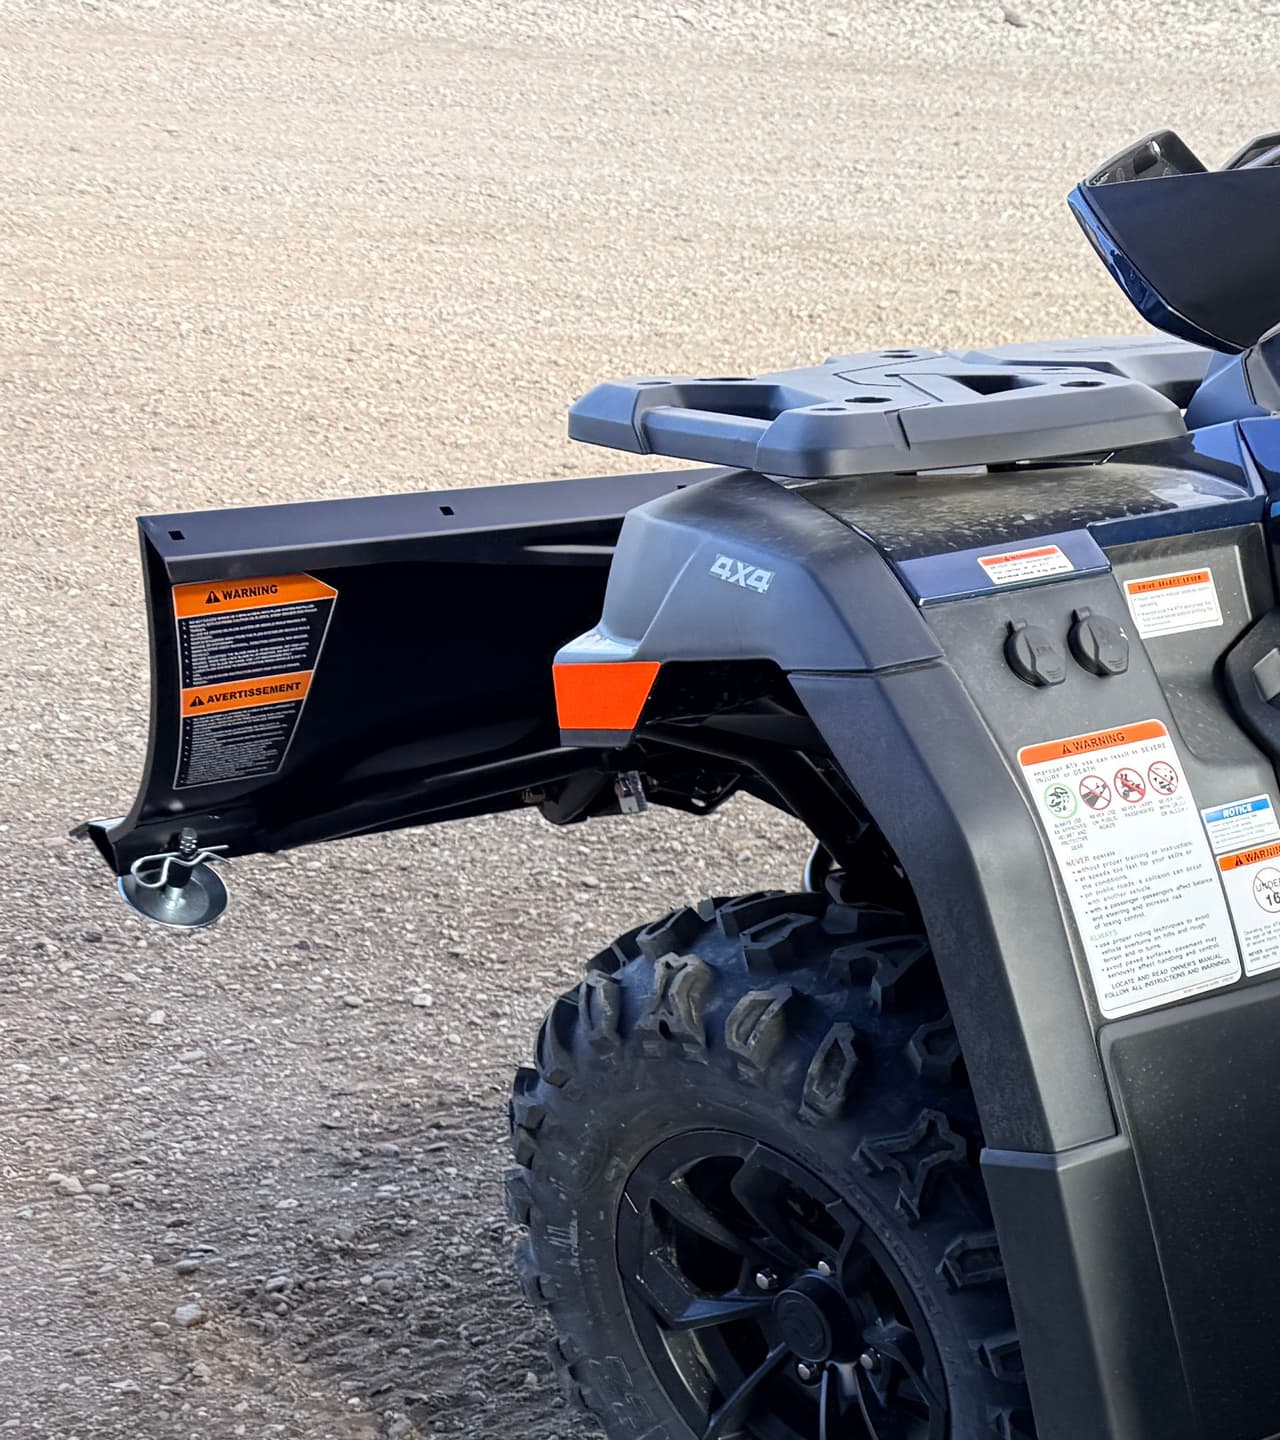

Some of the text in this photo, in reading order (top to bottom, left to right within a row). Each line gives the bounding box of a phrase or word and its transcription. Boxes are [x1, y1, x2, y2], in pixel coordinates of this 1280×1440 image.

[222, 584, 278, 600] WARNING
[206, 681, 302, 704] AVERTISSEMENT
[1073, 732, 1126, 752] WARNING
[1223, 803, 1253, 819] NOTICE
[1066, 857, 1090, 868] NEVER
[1104, 988, 1130, 1000] FOLLOW
[1131, 984, 1143, 992] ALL
[1144, 972, 1186, 988] INSTRUCTIONS
[1187, 968, 1200, 976] AND
[1111, 978, 1135, 990] LOCATE
[1137, 974, 1151, 983] AND
[1151, 969, 1169, 978] READ
